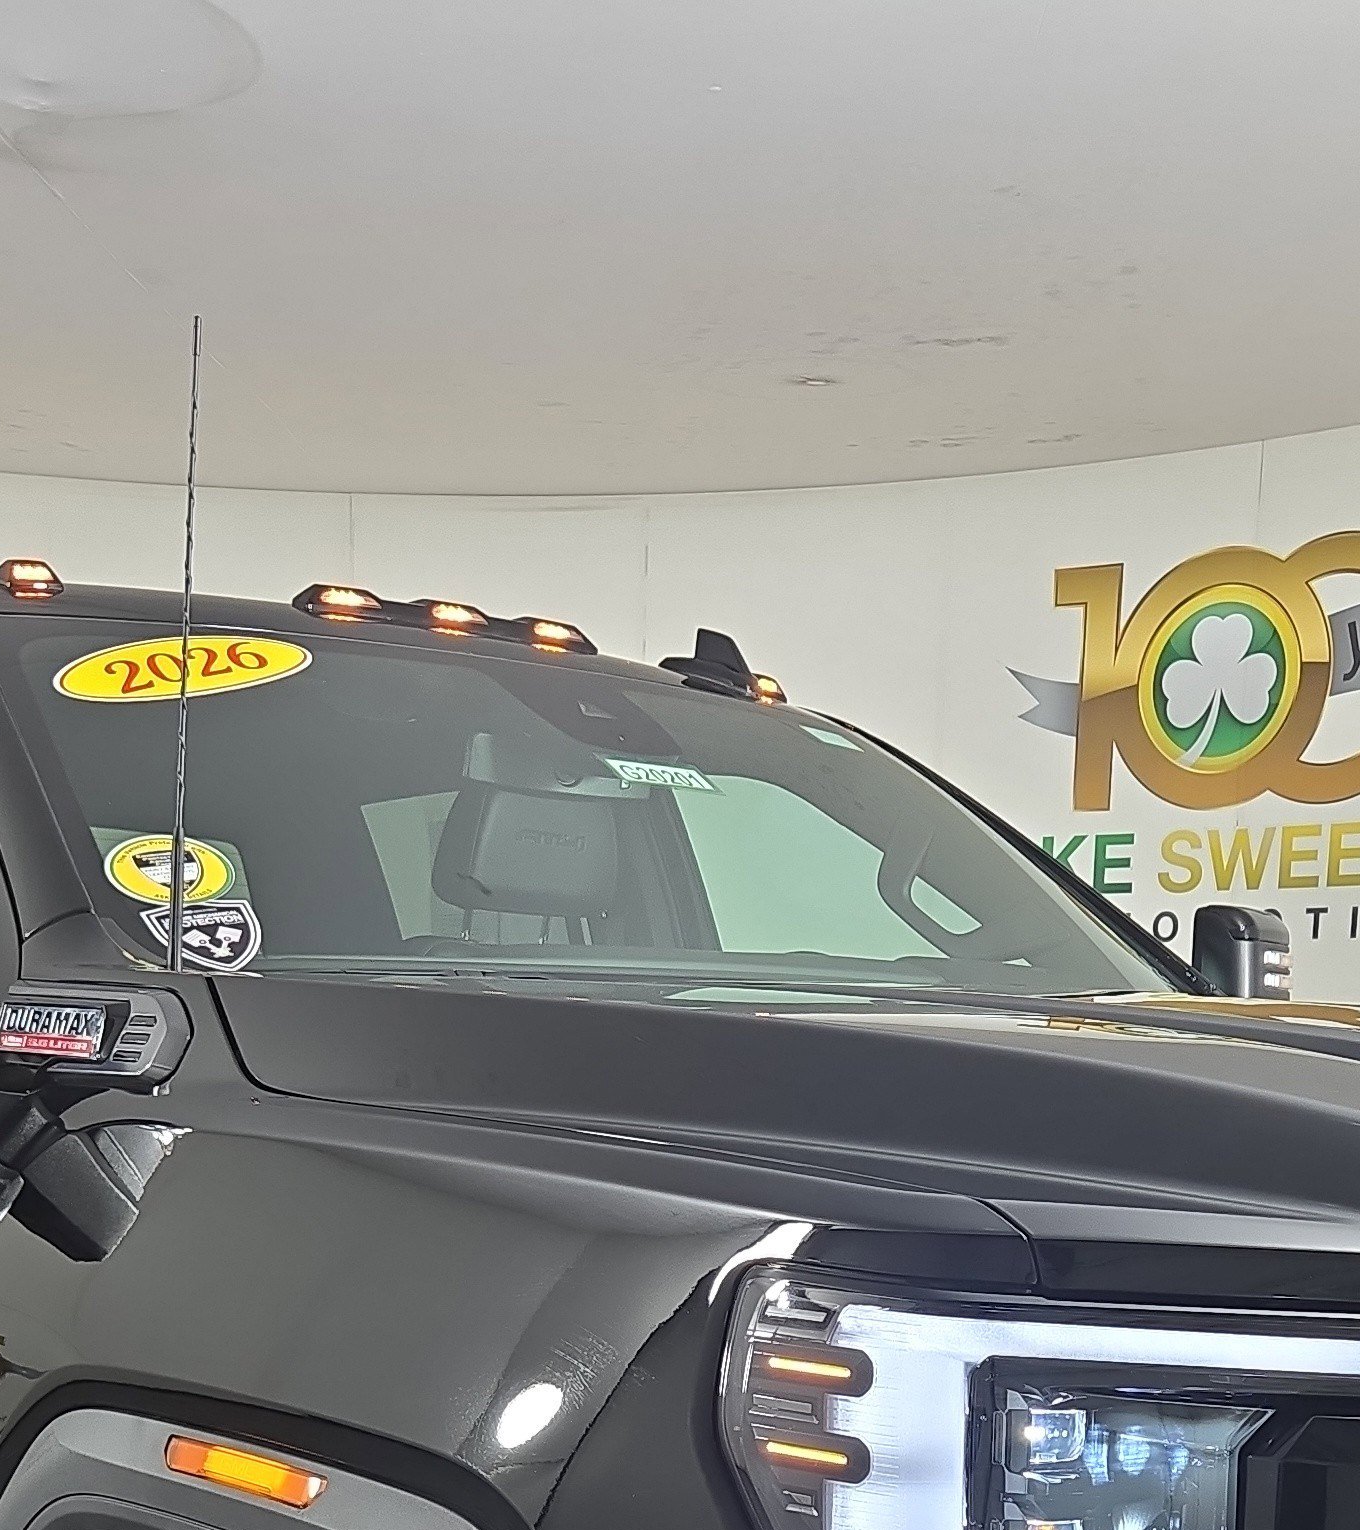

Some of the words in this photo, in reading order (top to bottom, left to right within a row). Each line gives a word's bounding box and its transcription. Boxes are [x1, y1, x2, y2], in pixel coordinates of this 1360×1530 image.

[104, 641, 269, 694] 2026
[619, 764, 707, 789] G20201
[4, 1006, 97, 1037] DURAMAX
